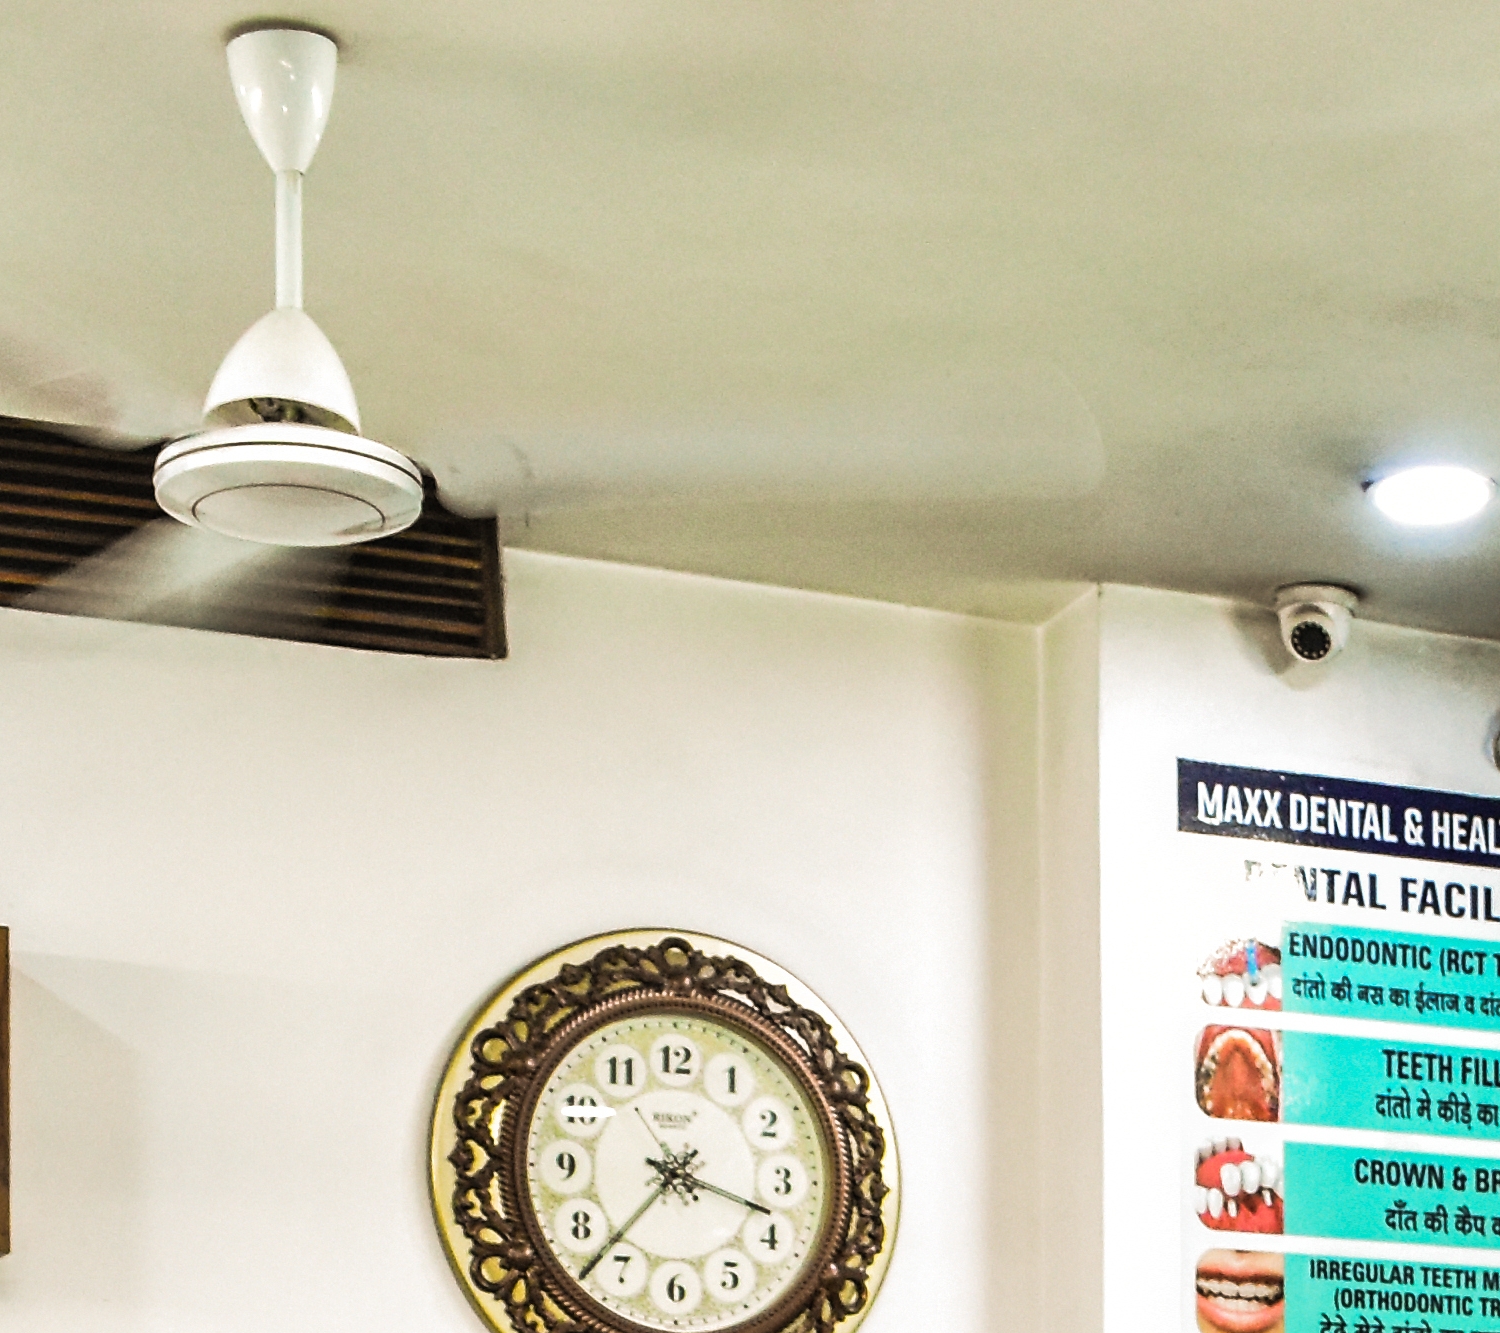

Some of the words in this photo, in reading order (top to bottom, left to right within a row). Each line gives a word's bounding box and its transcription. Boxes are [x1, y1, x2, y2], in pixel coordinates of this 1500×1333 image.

[1196, 782, 1283, 829] MAXX
[1290, 794, 1398, 842] DENTAL
[1405, 807, 1425, 847] &
[1290, 933, 1431, 970] ENDODONTIC
[1440, 948, 1487, 977] (RCT
[605, 1056, 635, 1086] 11
[660, 1045, 692, 1075] 12
[1382, 1049, 1452, 1083] TEETH
[725, 1066, 737, 1093] 1
[760, 1111, 778, 1137] 2
[556, 1152, 576, 1180] 9
[1355, 1158, 1444, 1190] CROWN
[1453, 1166, 1467, 1192] &
[774, 1167, 792, 1195] 3
[571, 1211, 591, 1239] 8
[760, 1224, 779, 1251] 4
[613, 1255, 632, 1284] 7
[721, 1262, 740, 1290] 5
[1310, 1259, 1414, 1285] IRREGULAR
[1420, 1266, 1476, 1289] TEETH
[668, 1274, 687, 1302] 6
[1334, 1288, 1473, 1316] (ORTHODONTIC
